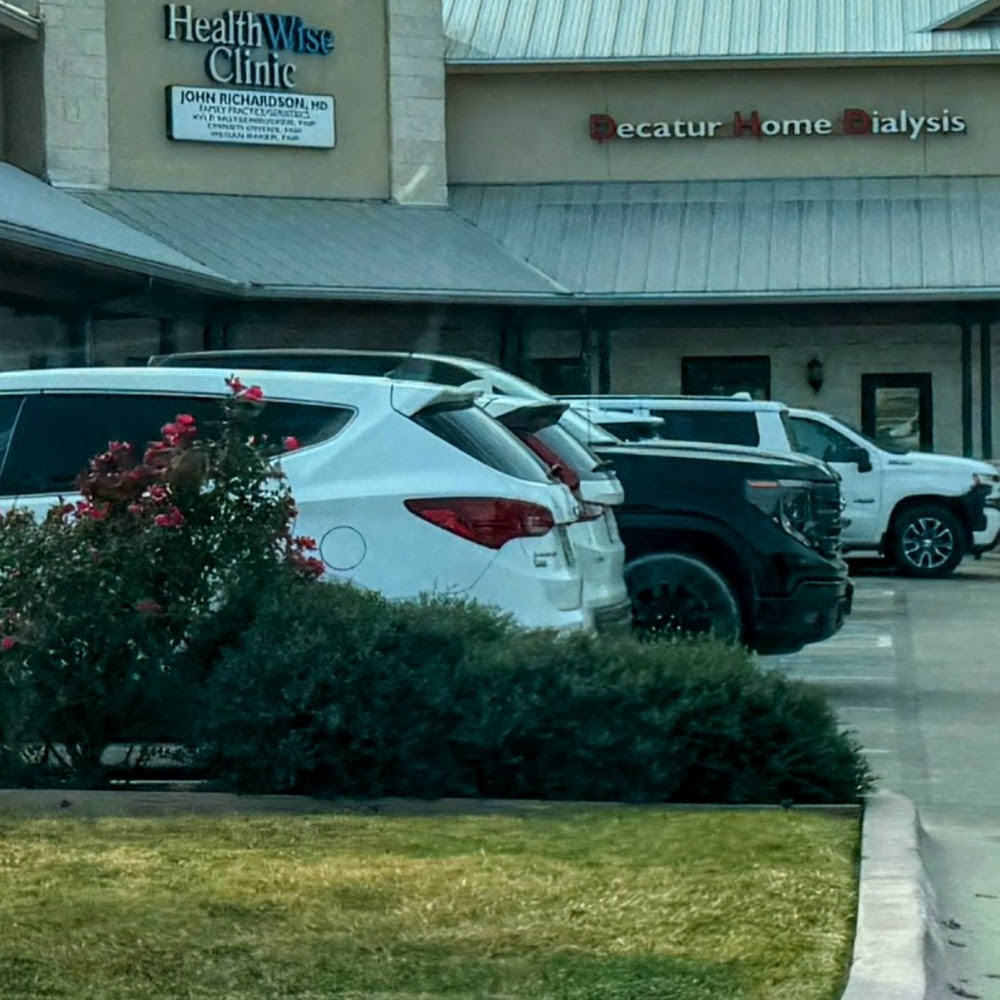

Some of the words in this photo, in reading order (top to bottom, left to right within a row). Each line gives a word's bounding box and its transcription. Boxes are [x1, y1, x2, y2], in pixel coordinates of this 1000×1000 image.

[166, 3, 336, 56] HealthWise
[208, 45, 298, 89] Clinic
[180, 90, 216, 105] JOHN
[219, 92, 309, 111] RICHARDSON,
[310, 100, 329, 112] MD
[588, 112, 723, 142] Decatur
[733, 110, 833, 141] Home
[842, 107, 968, 140] Dialysis
